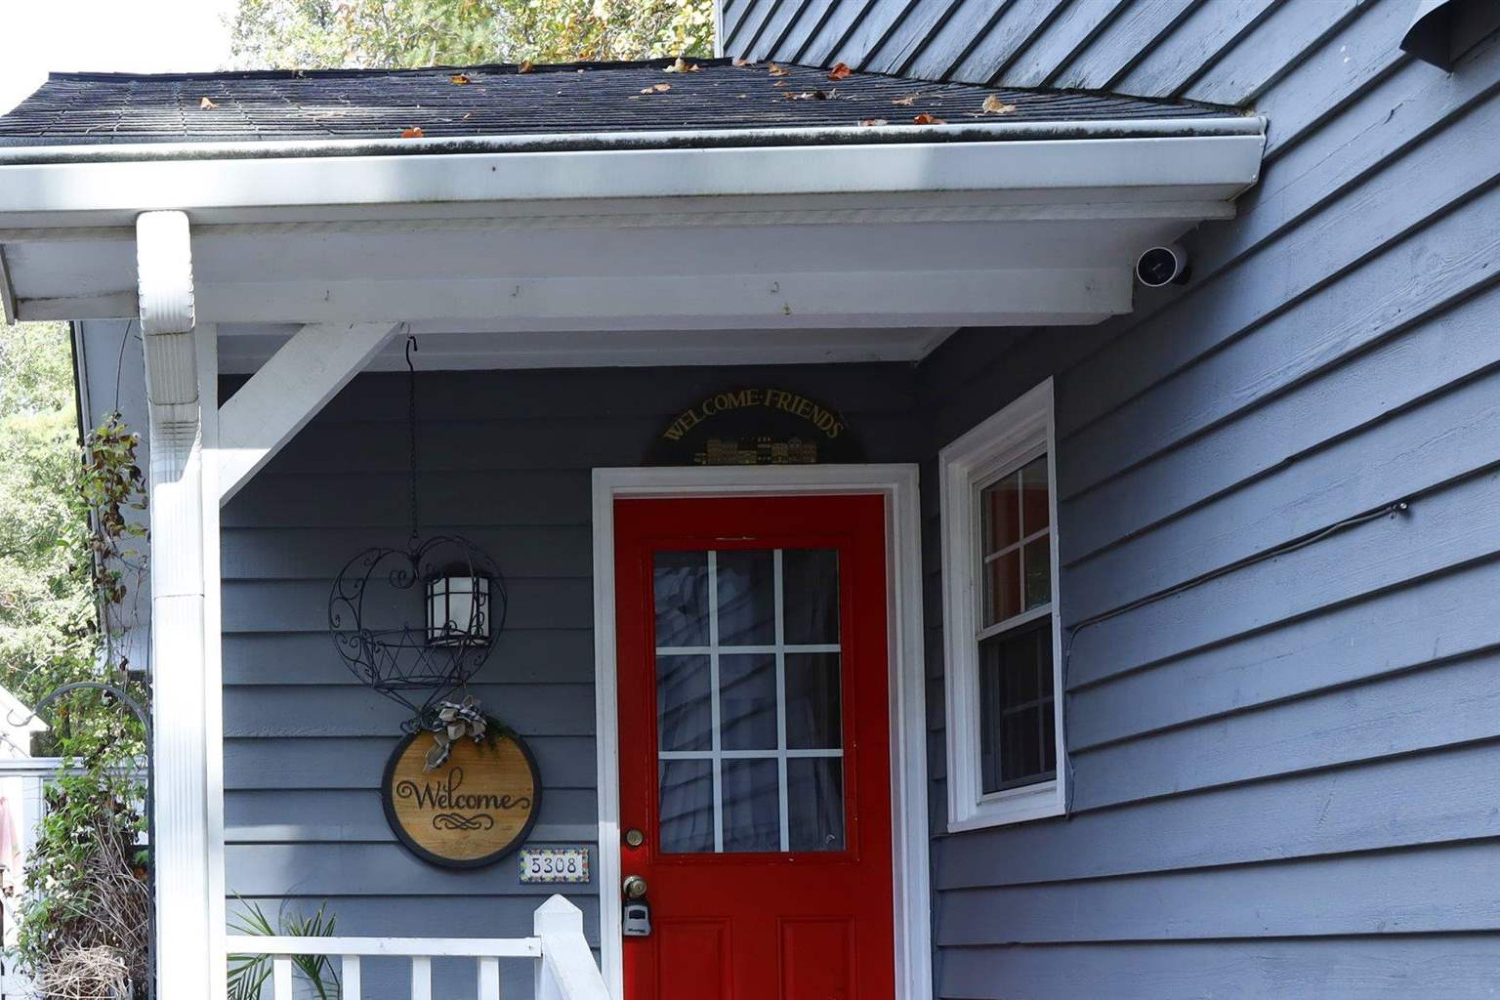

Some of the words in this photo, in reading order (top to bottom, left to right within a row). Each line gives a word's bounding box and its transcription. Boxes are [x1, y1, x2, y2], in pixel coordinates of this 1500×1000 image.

[664, 389, 759, 440] WELCOME
[764, 389, 843, 438] FRIENDS
[396, 766, 530, 810] Welcome
[531, 857, 577, 874] 5308
